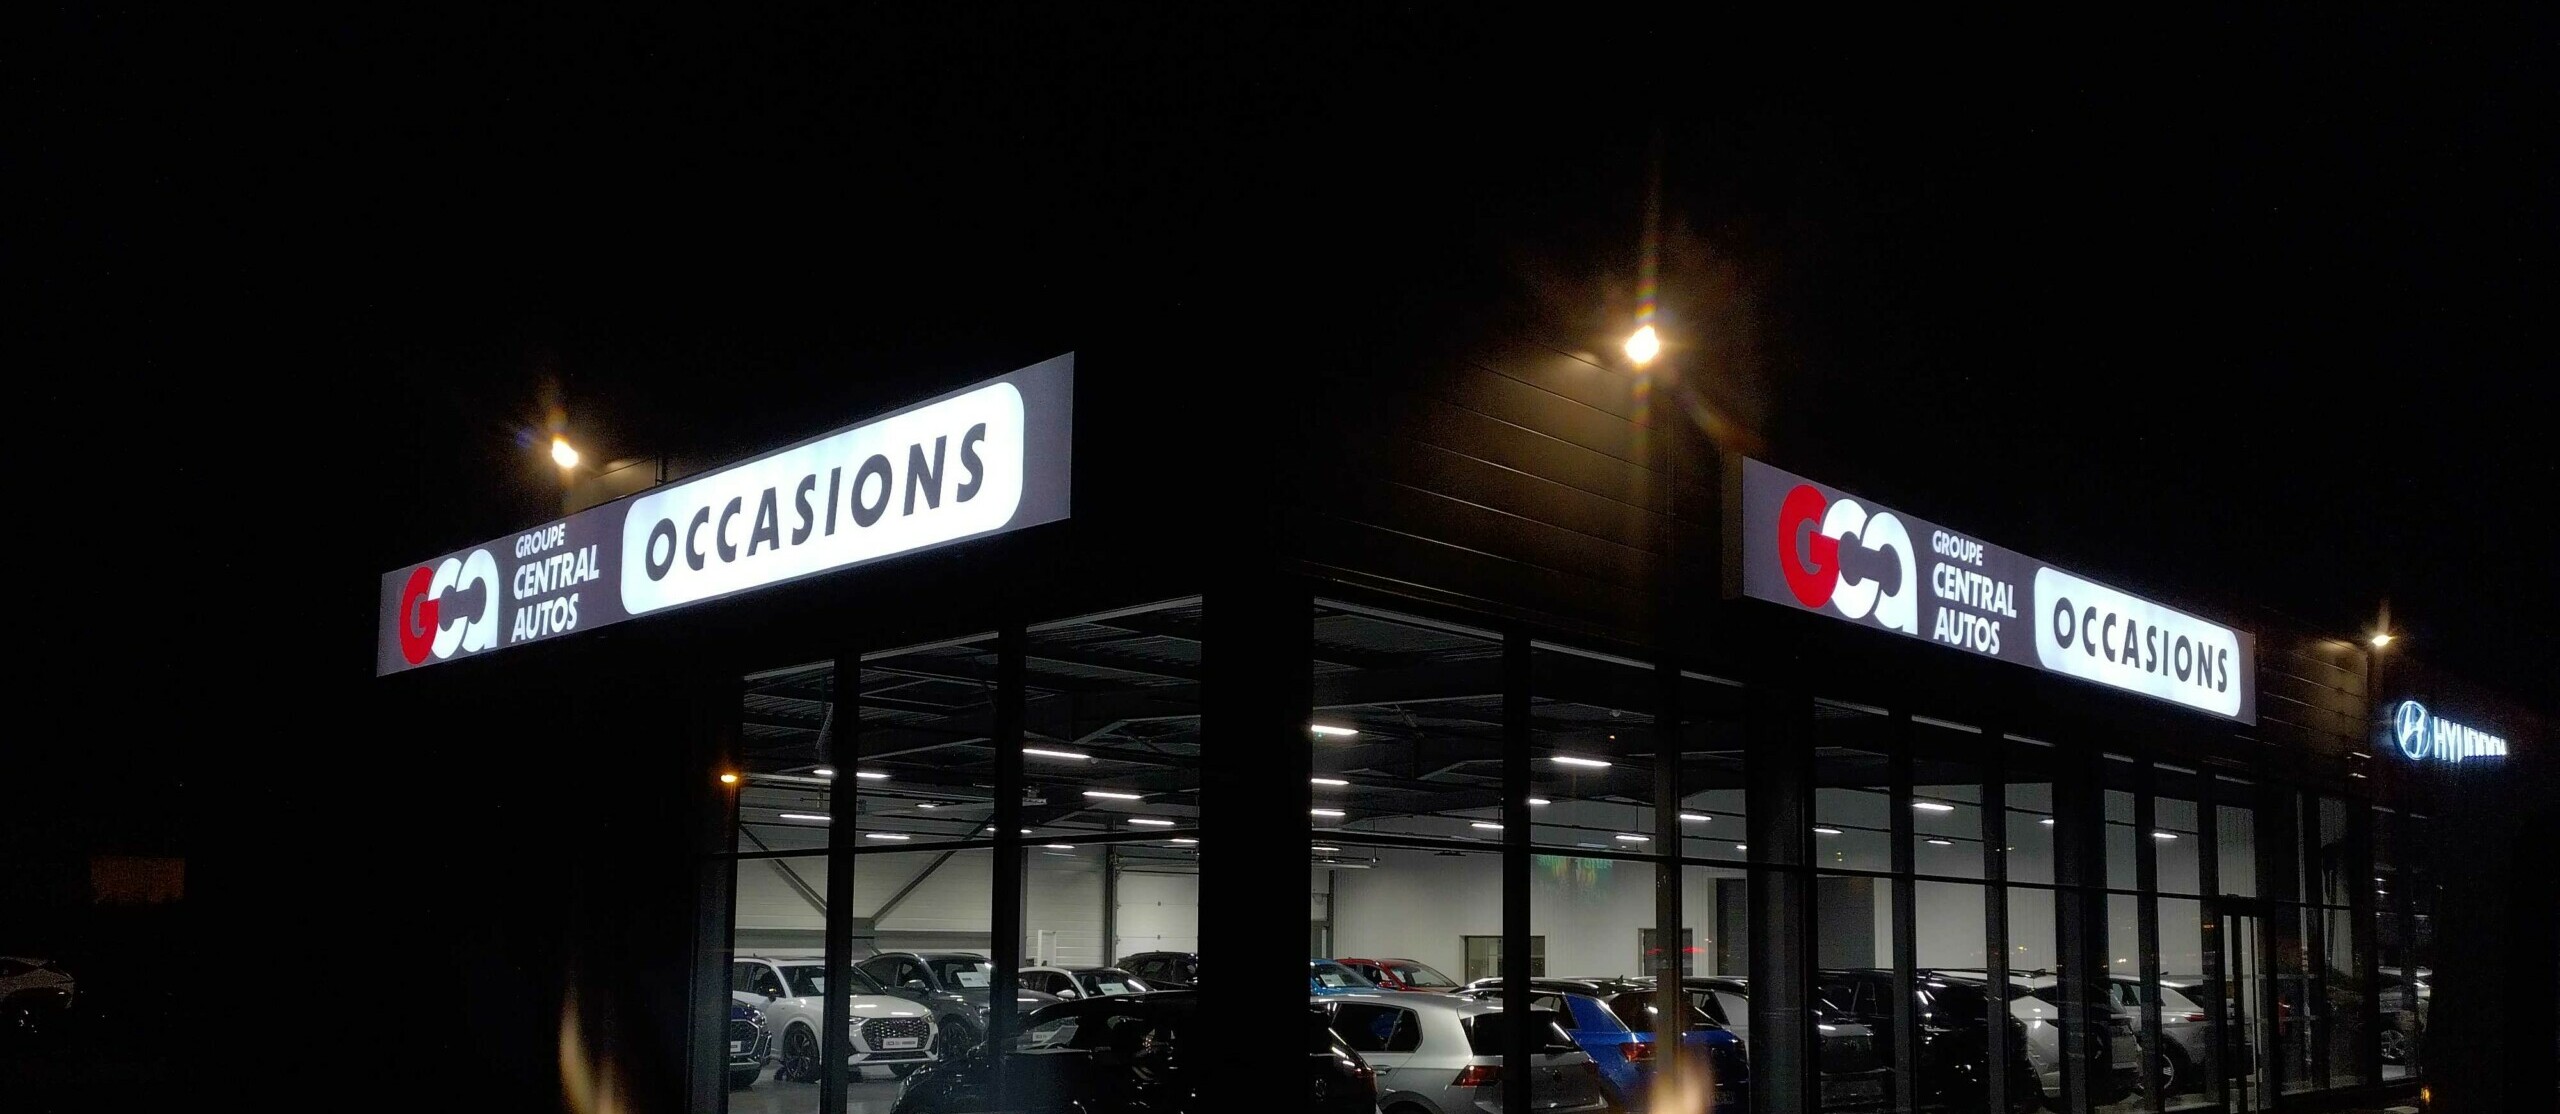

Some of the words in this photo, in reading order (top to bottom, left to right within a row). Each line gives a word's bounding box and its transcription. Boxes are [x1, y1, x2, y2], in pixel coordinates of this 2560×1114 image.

[645, 422, 986, 582] OCCASIONS
[515, 523, 566, 559] GROUPE
[1932, 530, 1984, 567] GROUPE
[513, 545, 600, 600] CENTRAL
[1932, 562, 2017, 618] CENTRAL
[510, 593, 579, 643] AUTOS
[1933, 607, 2000, 655] AUTOS
[2053, 597, 2227, 693] OCCASIONS
